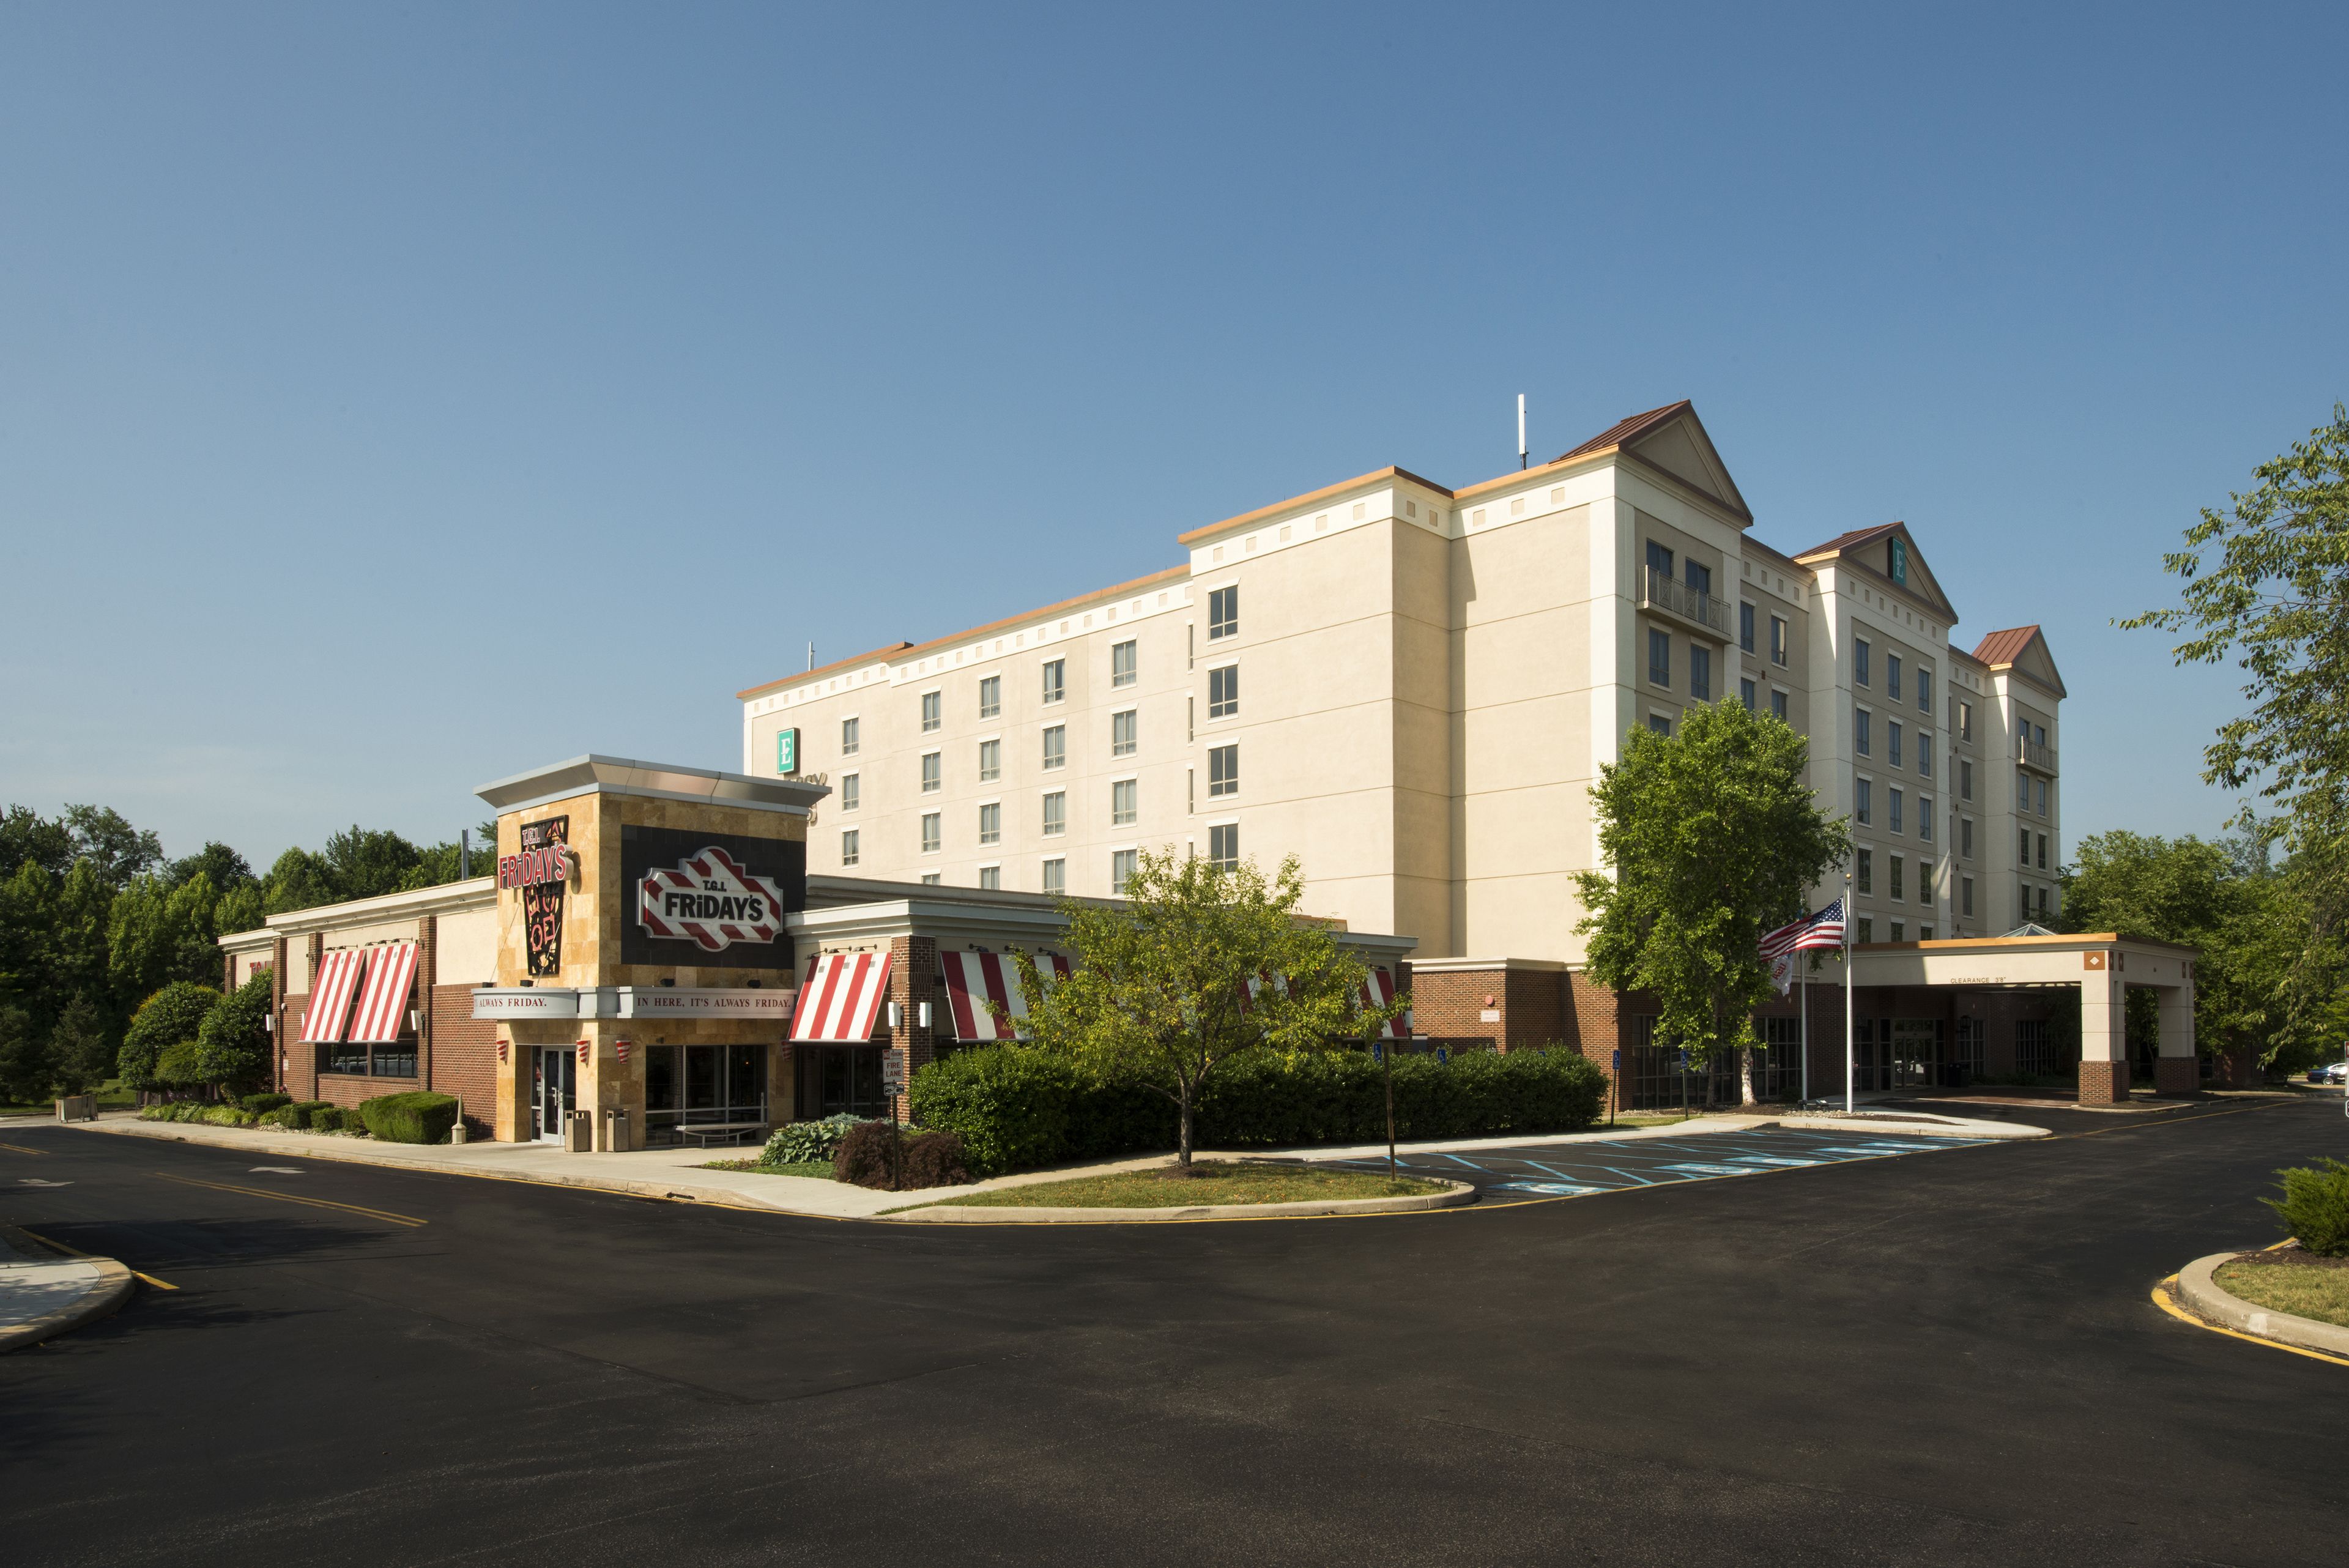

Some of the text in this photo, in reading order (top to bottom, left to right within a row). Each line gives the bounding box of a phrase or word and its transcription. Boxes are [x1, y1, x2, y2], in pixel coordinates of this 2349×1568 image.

[522, 827, 540, 845] T.G.I.
[703, 880, 727, 892] T.G.I.
[480, 998, 503, 1007] ALWAYS
[508, 998, 547, 1007] FRIDAY.
[637, 997, 790, 1008] IN HERE, IT'S ALWAYS FRIDAY.
